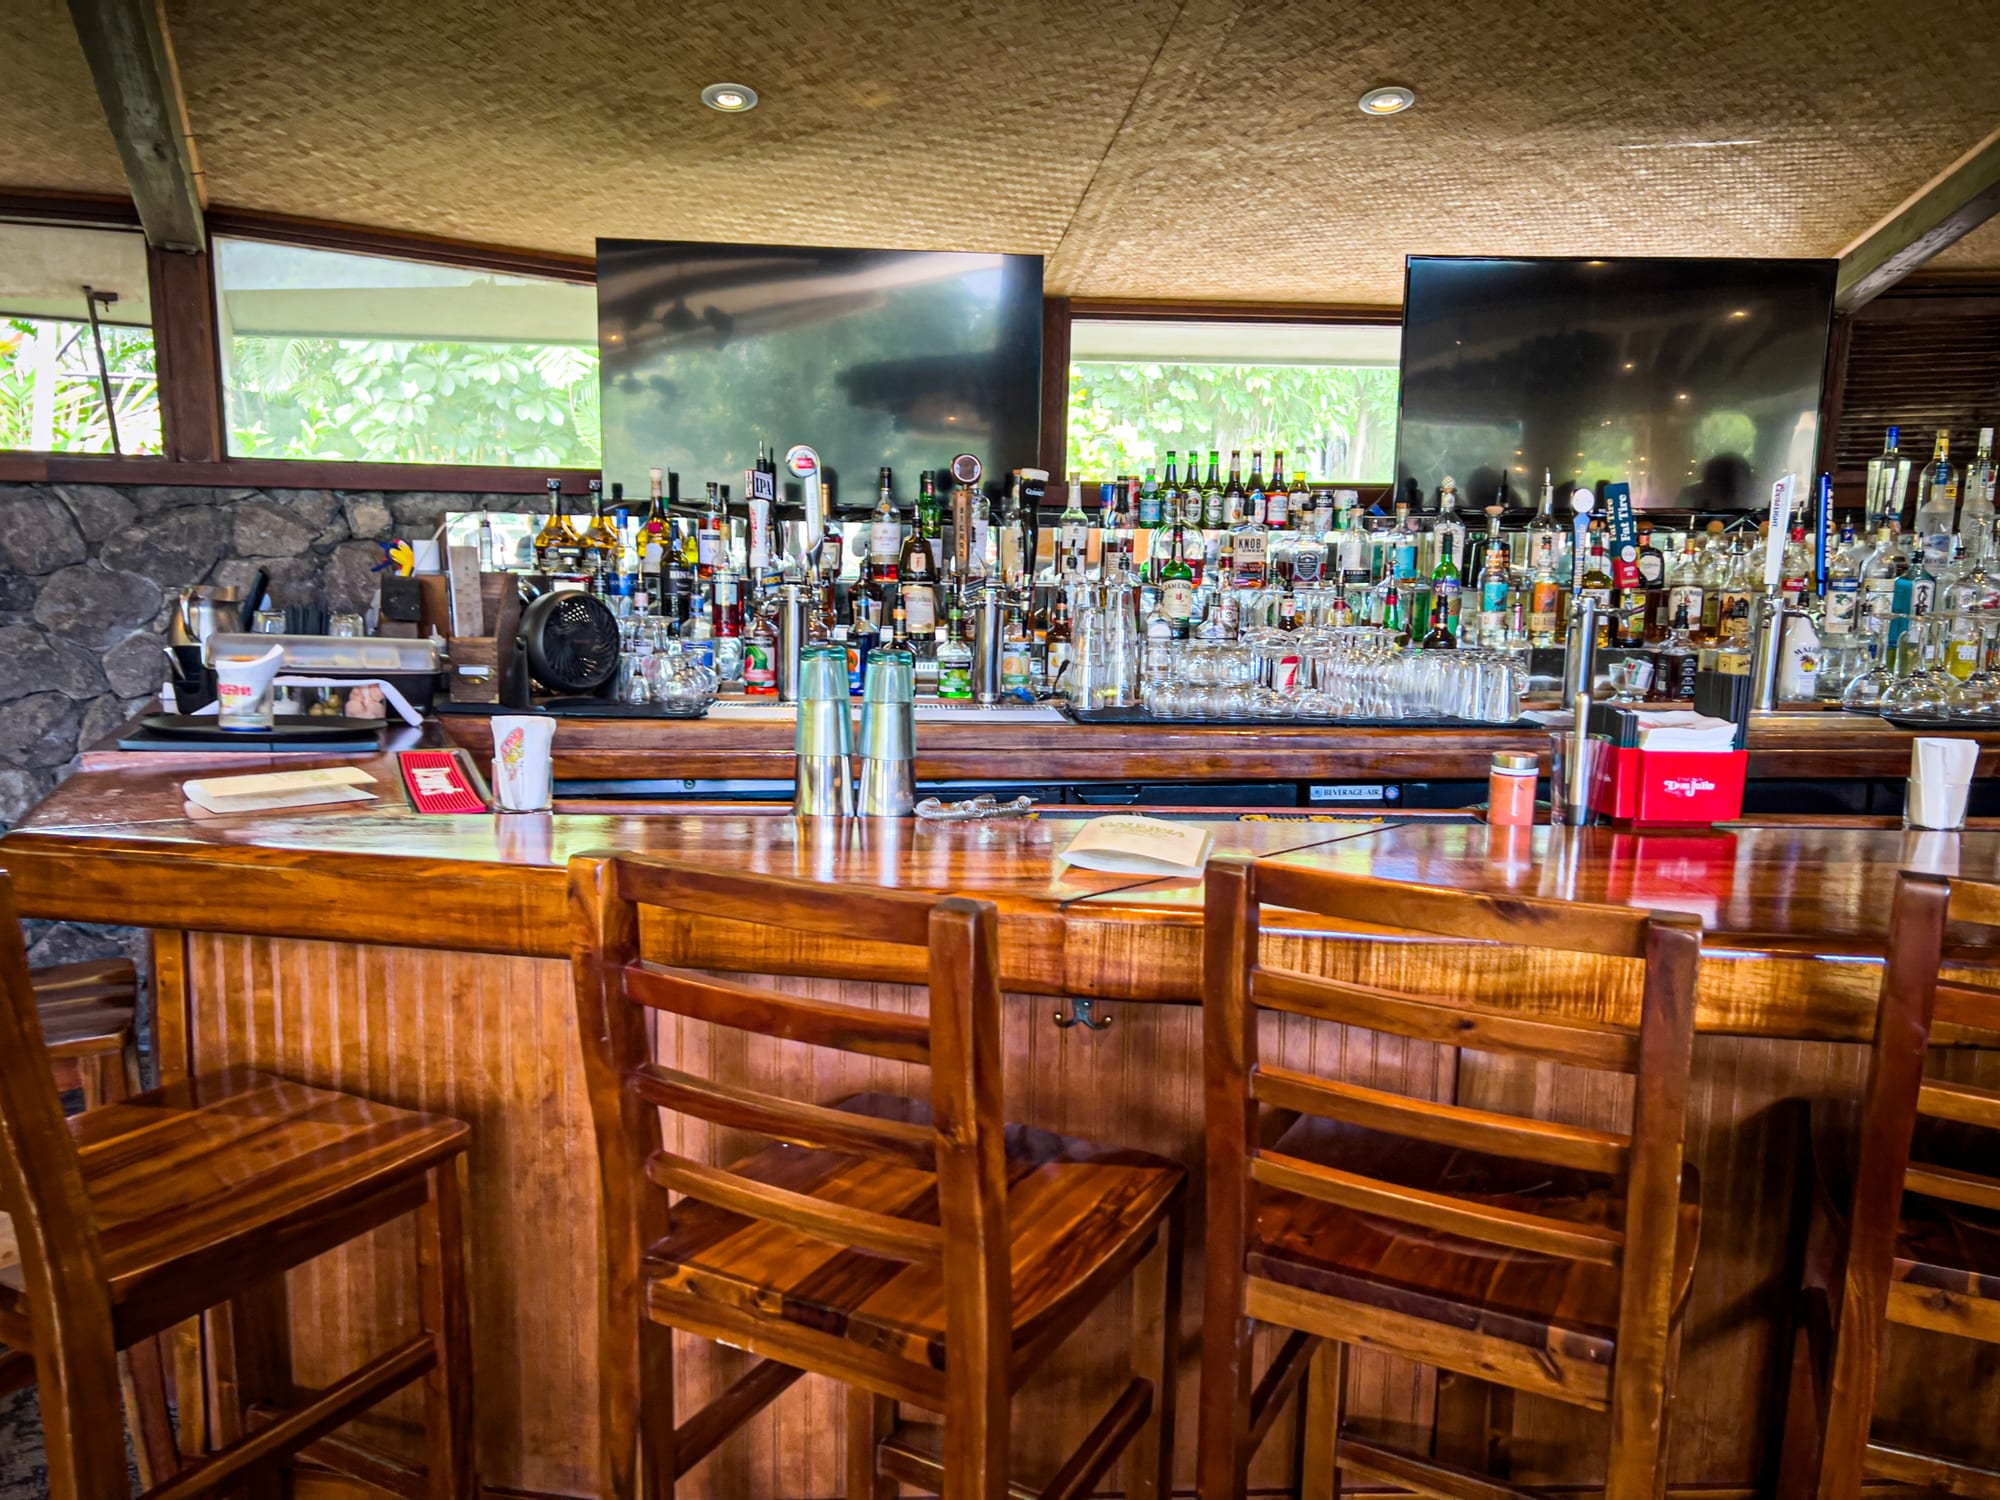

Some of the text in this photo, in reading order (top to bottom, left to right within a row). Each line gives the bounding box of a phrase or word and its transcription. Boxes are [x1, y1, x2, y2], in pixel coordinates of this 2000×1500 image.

[755, 477, 772, 496] IPA
[1617, 494, 1631, 542] Fat Tire
[1238, 538, 1262, 549] KNOB
[1280, 655, 1299, 695] 7
[1663, 779, 1715, 797] Don Julio
